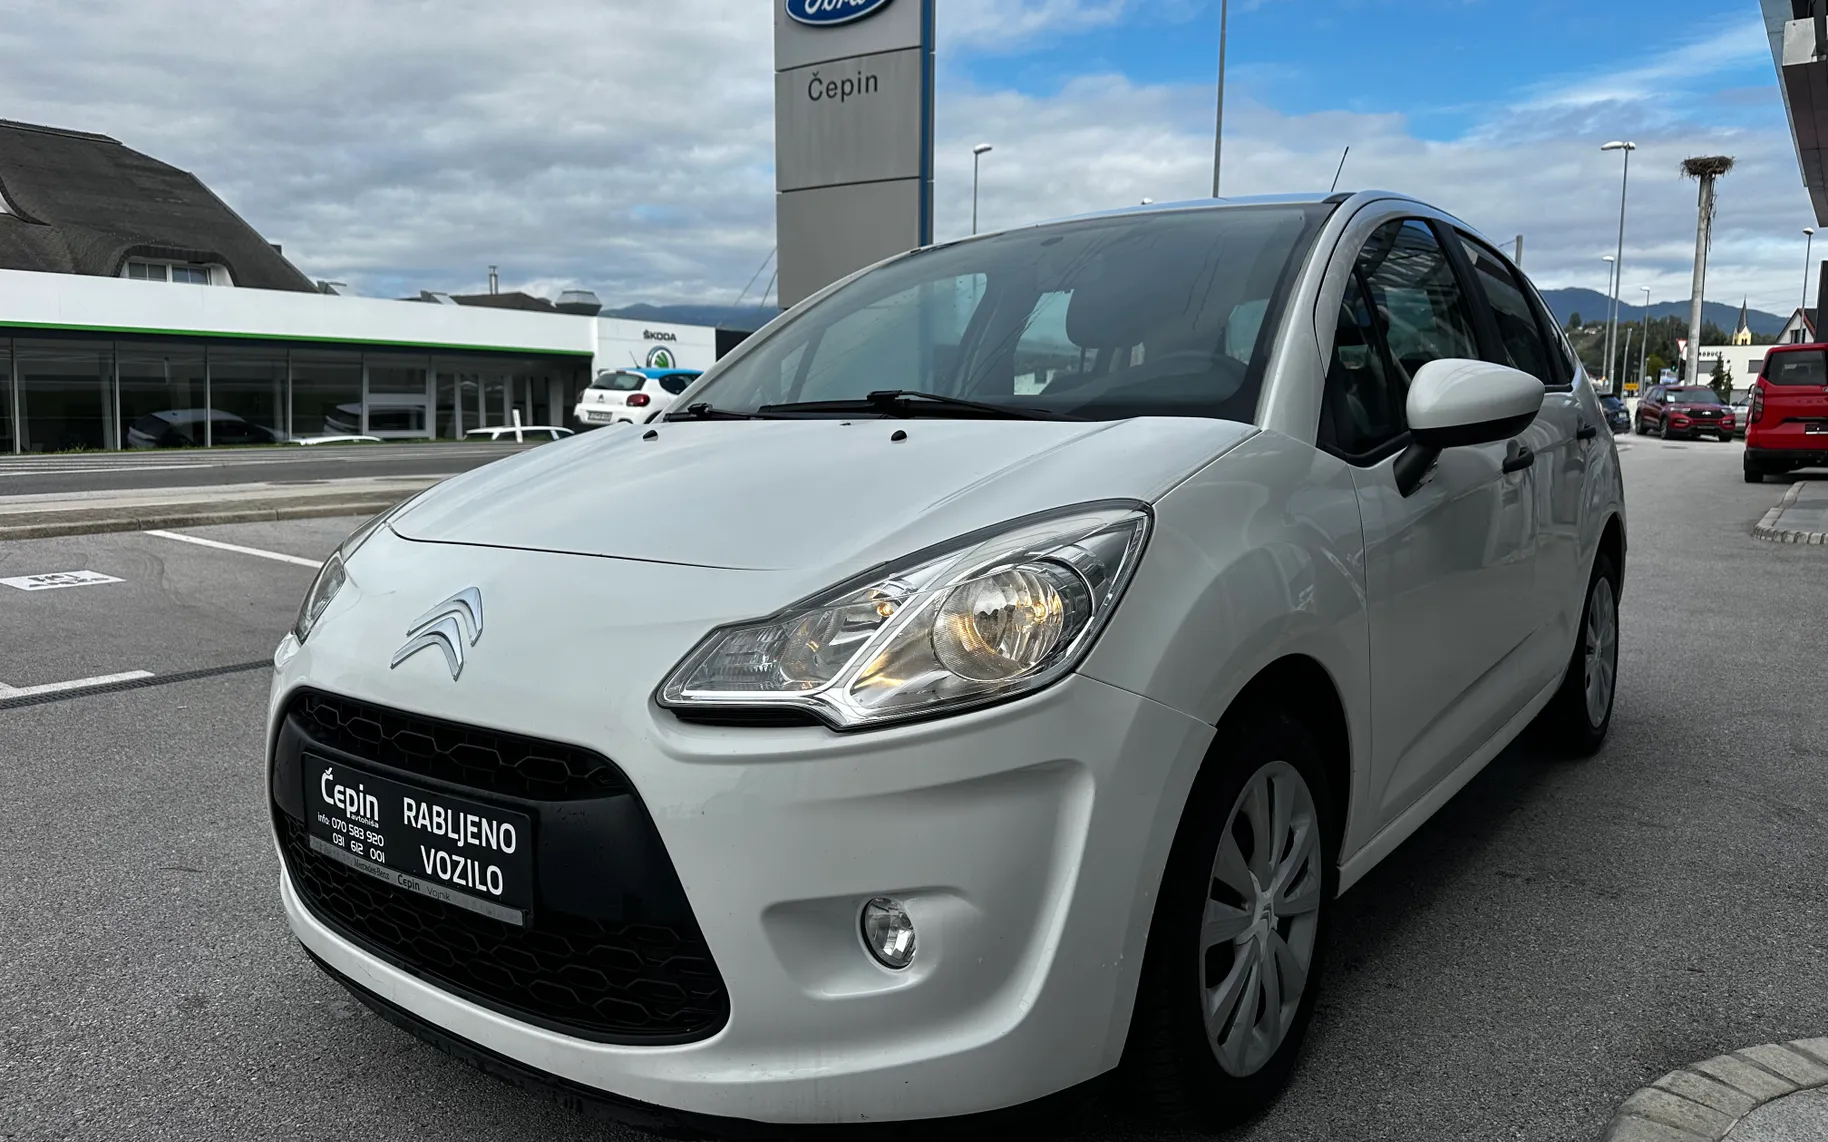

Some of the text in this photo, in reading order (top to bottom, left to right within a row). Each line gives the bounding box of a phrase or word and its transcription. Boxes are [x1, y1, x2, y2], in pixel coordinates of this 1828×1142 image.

[808, 71, 878, 103] Čepin
[643, 329, 677, 342] ŠKODA
[321, 767, 379, 821] Čepin
[331, 817, 347, 833] 070
[348, 823, 365, 840] 583
[366, 830, 385, 847] 920
[403, 796, 517, 854] RABLJENO
[332, 832, 346, 848] 031
[350, 840, 364, 856] 612
[369, 847, 386, 864] 001
[420, 845, 504, 896] VOZILO
[426, 886, 451, 901] Vojnik
